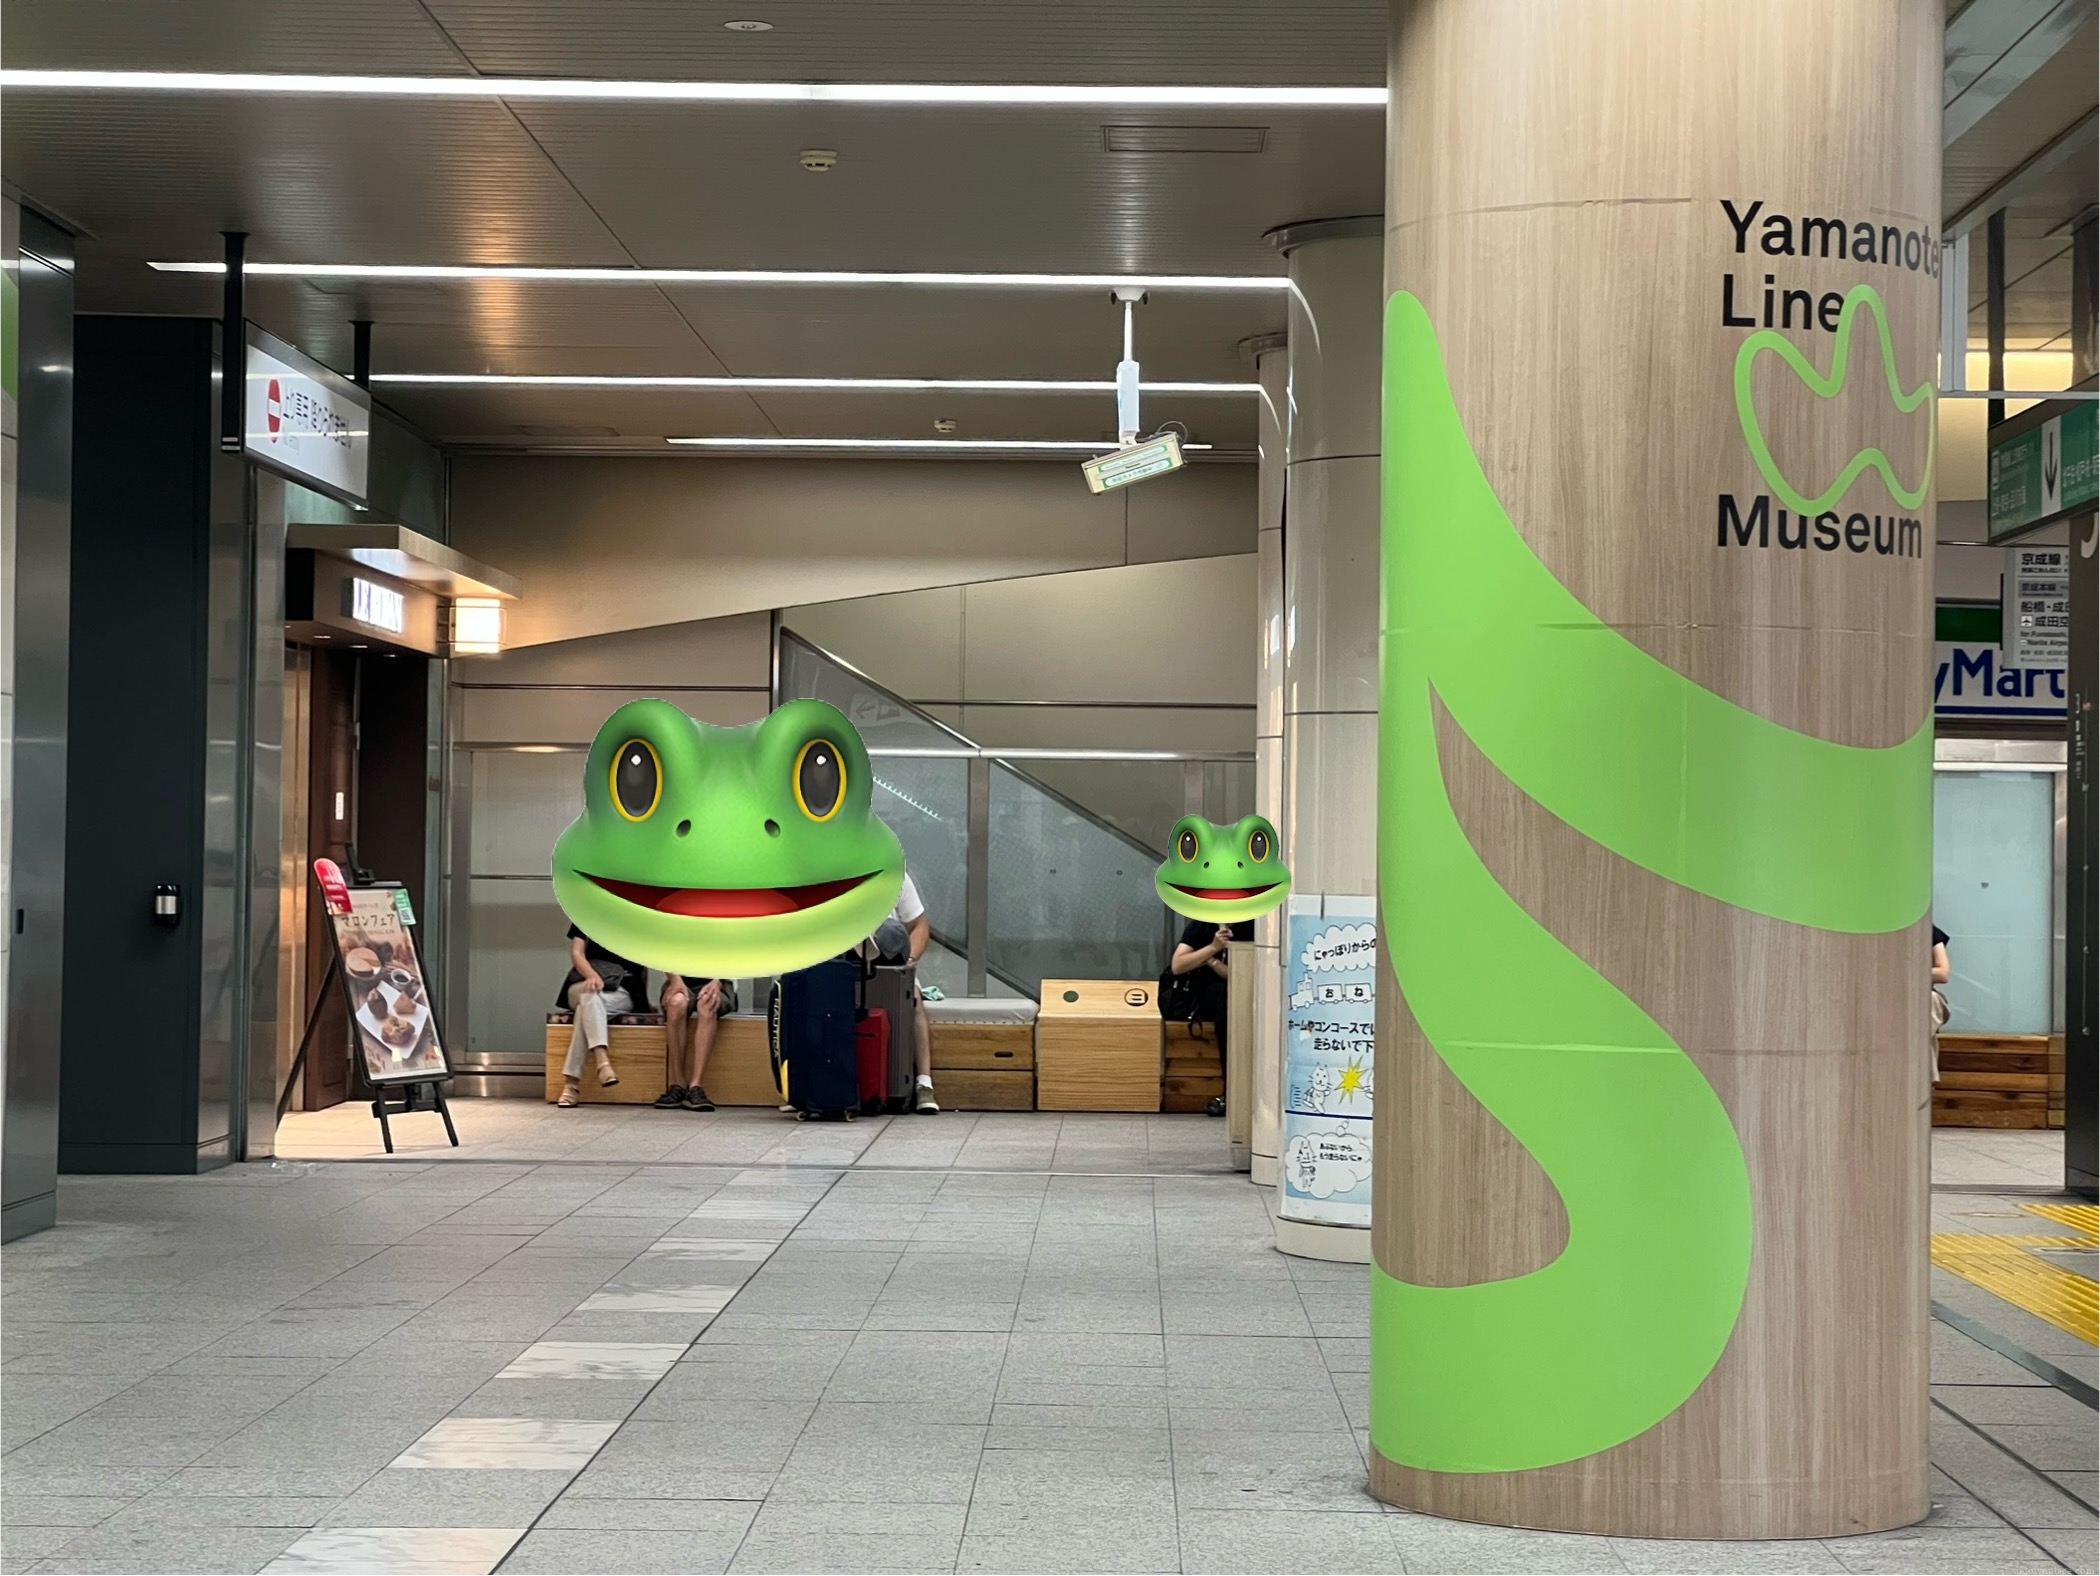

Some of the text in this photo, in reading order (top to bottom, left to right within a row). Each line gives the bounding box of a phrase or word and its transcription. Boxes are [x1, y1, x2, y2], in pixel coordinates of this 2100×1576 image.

[1720, 200, 1940, 279] Yamanote
[1722, 273, 1845, 332] Line
[1717, 494, 1922, 559] Museum
[341, 913, 395, 927] マロンフェア
[1325, 985, 1364, 998] お ね
